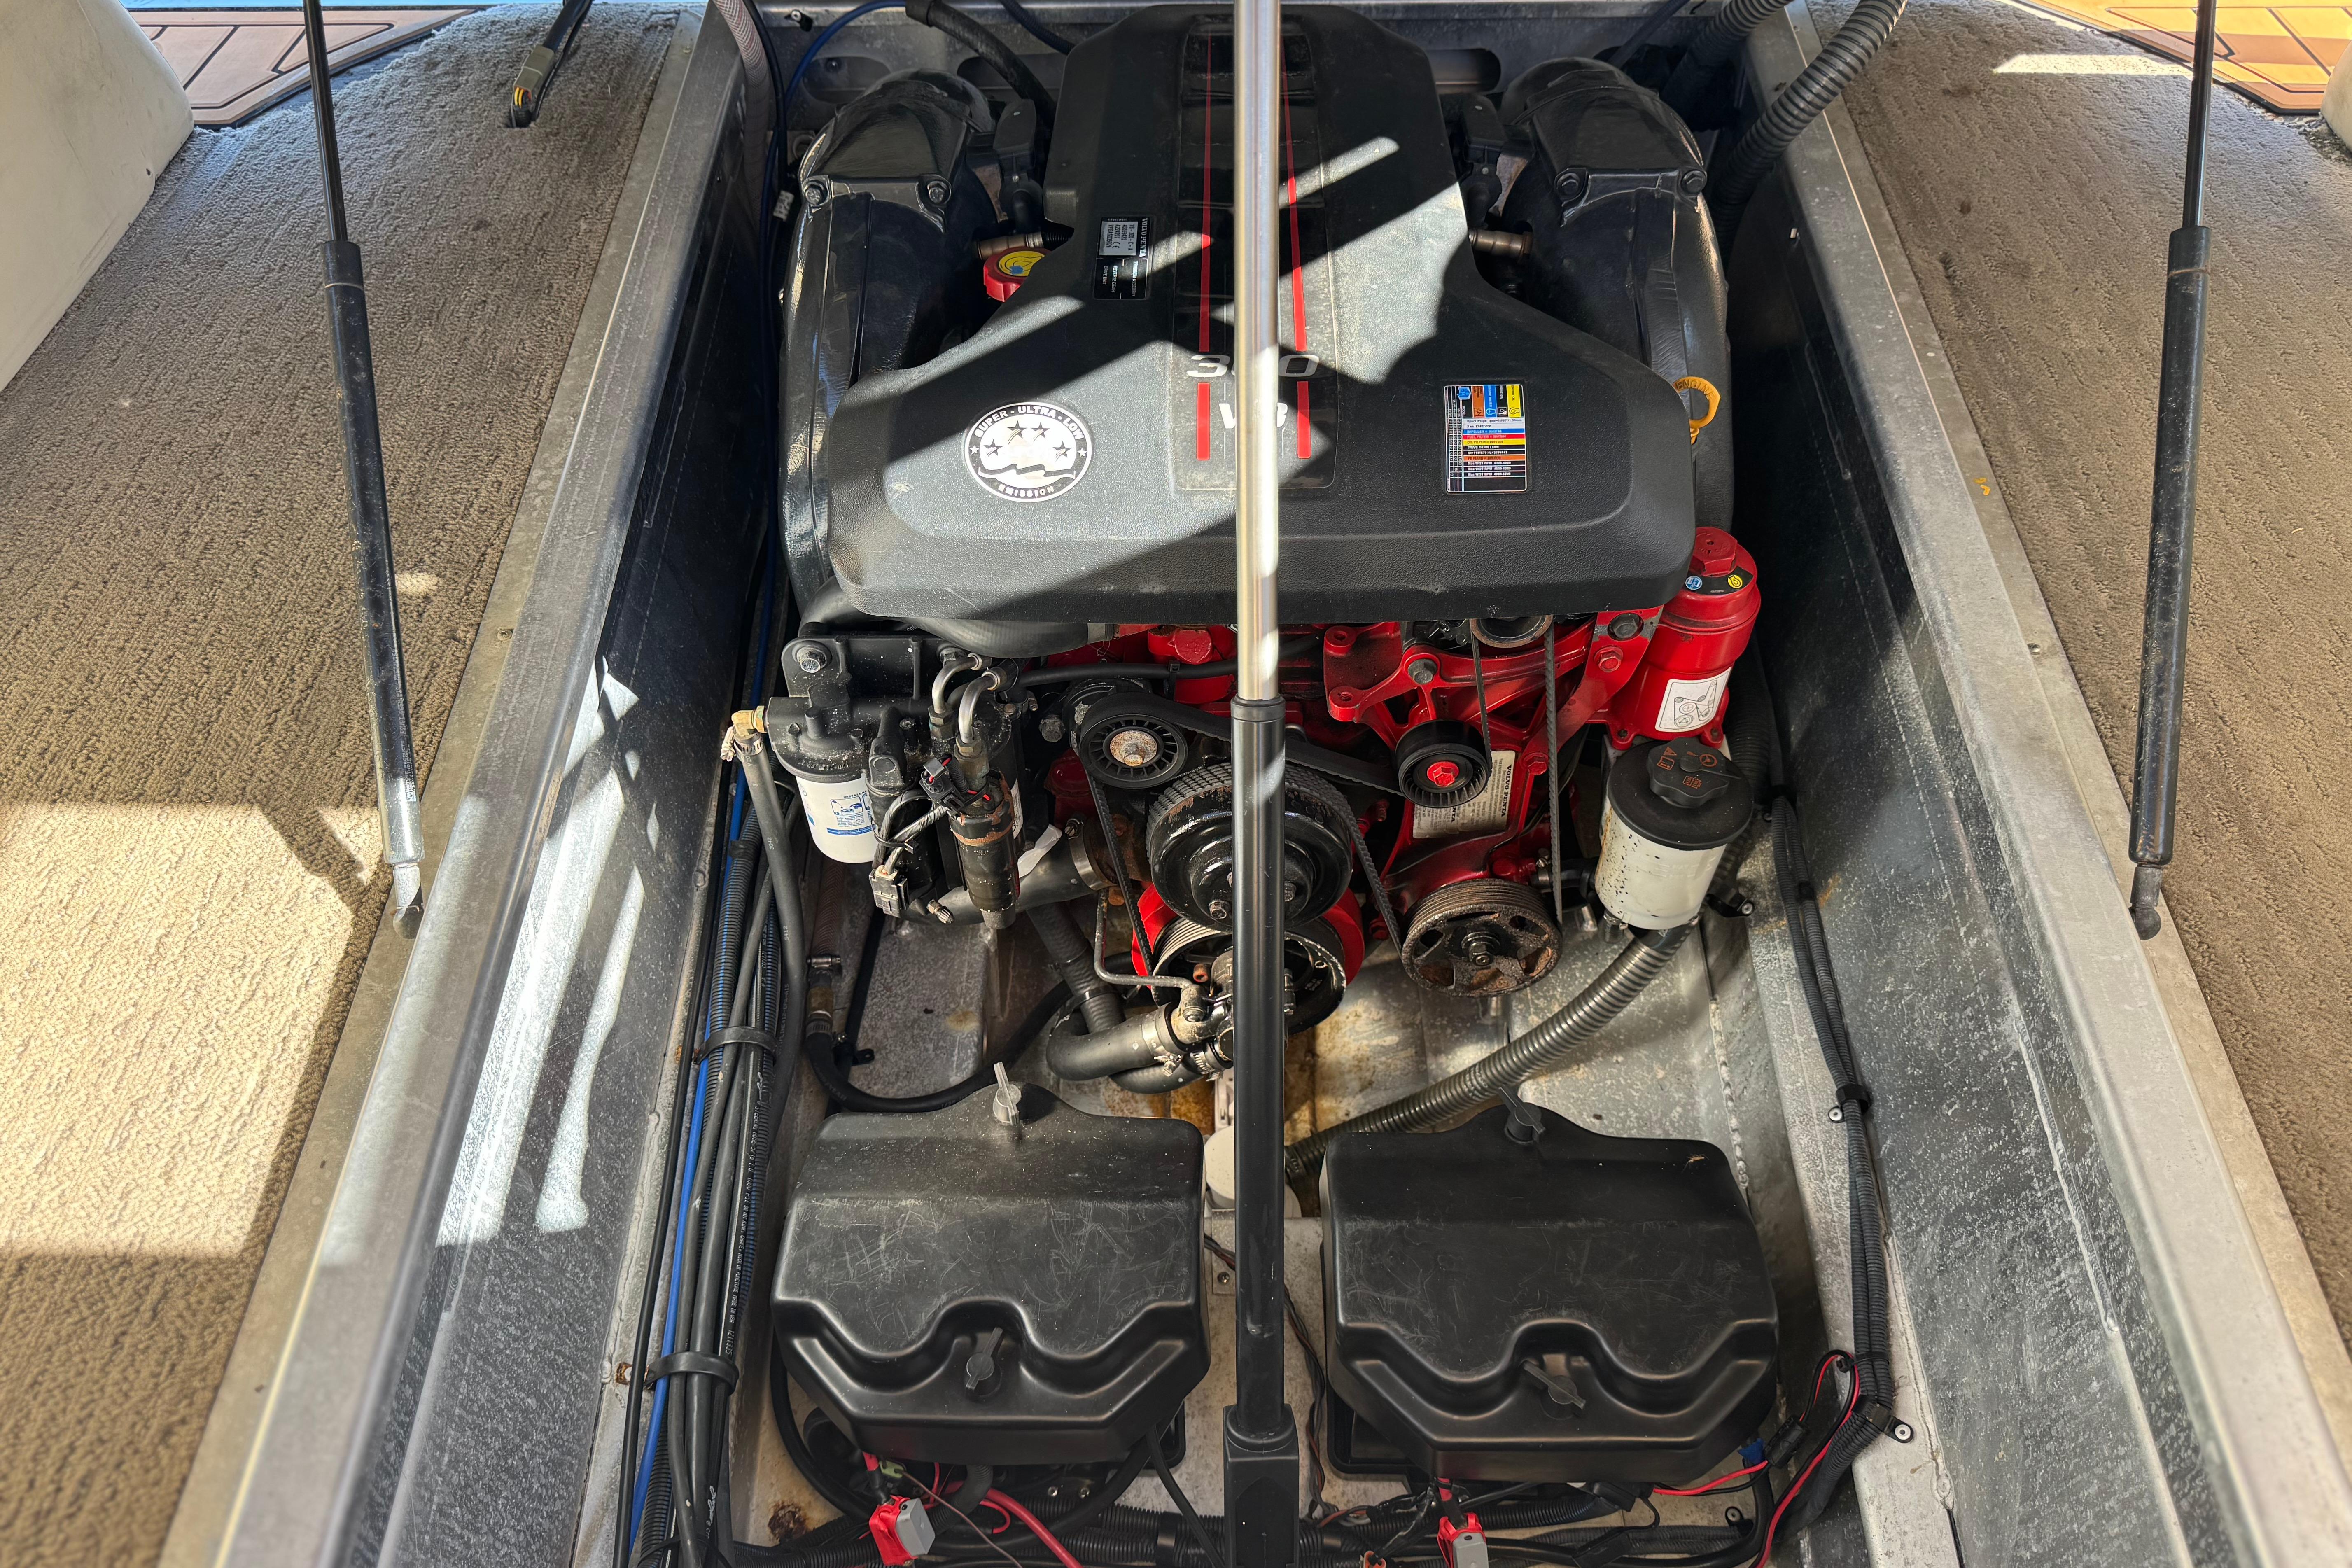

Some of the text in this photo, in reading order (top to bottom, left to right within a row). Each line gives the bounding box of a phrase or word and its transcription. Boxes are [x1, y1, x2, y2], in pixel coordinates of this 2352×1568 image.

[1187, 355, 1319, 377] 30
[974, 405, 1085, 440] SUPER ULTRA LOW
[997, 484, 1054, 497] EMISSION
